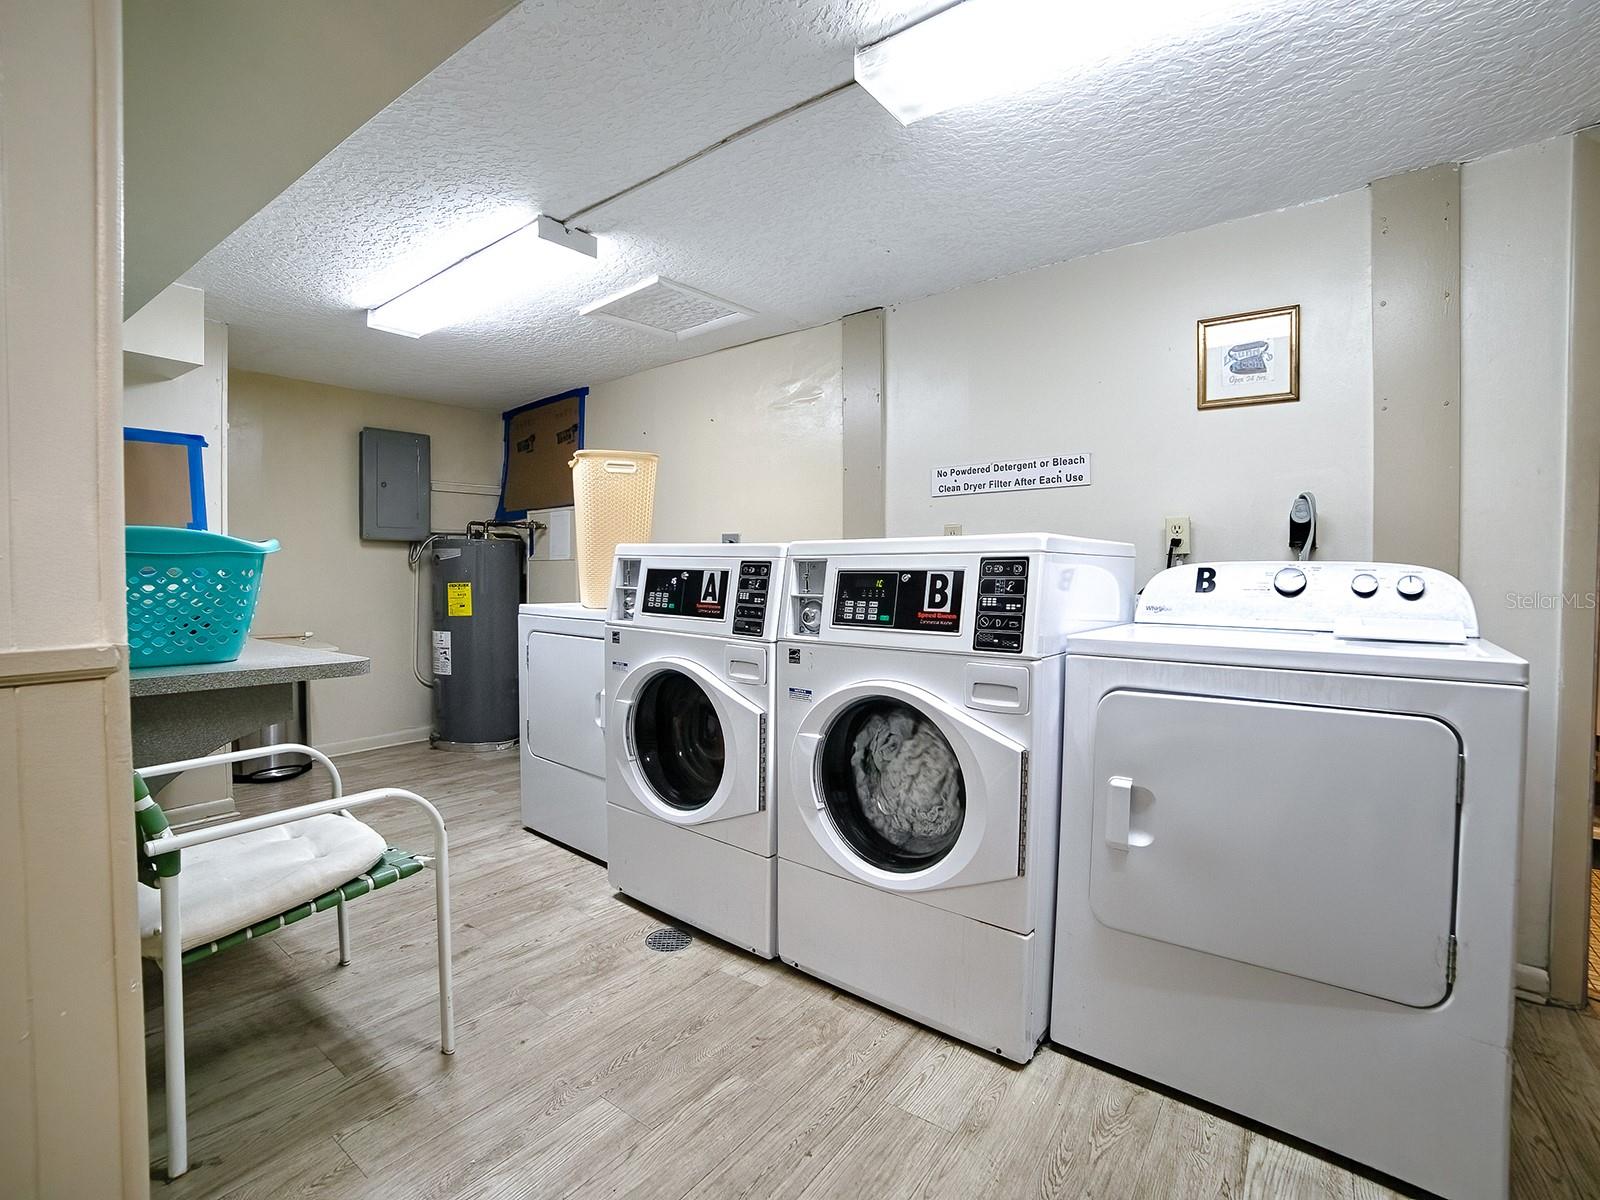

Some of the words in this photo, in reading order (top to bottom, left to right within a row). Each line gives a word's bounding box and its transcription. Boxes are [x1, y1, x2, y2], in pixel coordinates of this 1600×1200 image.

[936, 470, 948, 478] No
[950, 465, 991, 477] Powdered
[993, 460, 1037, 473] Detergent
[1039, 460, 1049, 468] or
[1052, 455, 1085, 466] Bleach
[938, 484, 961, 493] Clean
[963, 482, 986, 493] Dryer
[988, 479, 1012, 489] Filter
[1014, 477, 1037, 487] After
[1039, 474, 1062, 485] Each
[1065, 473, 1084, 483] Use
[702, 572, 717, 602] A
[927, 573, 949, 609] B
[1195, 567, 1217, 593] B
